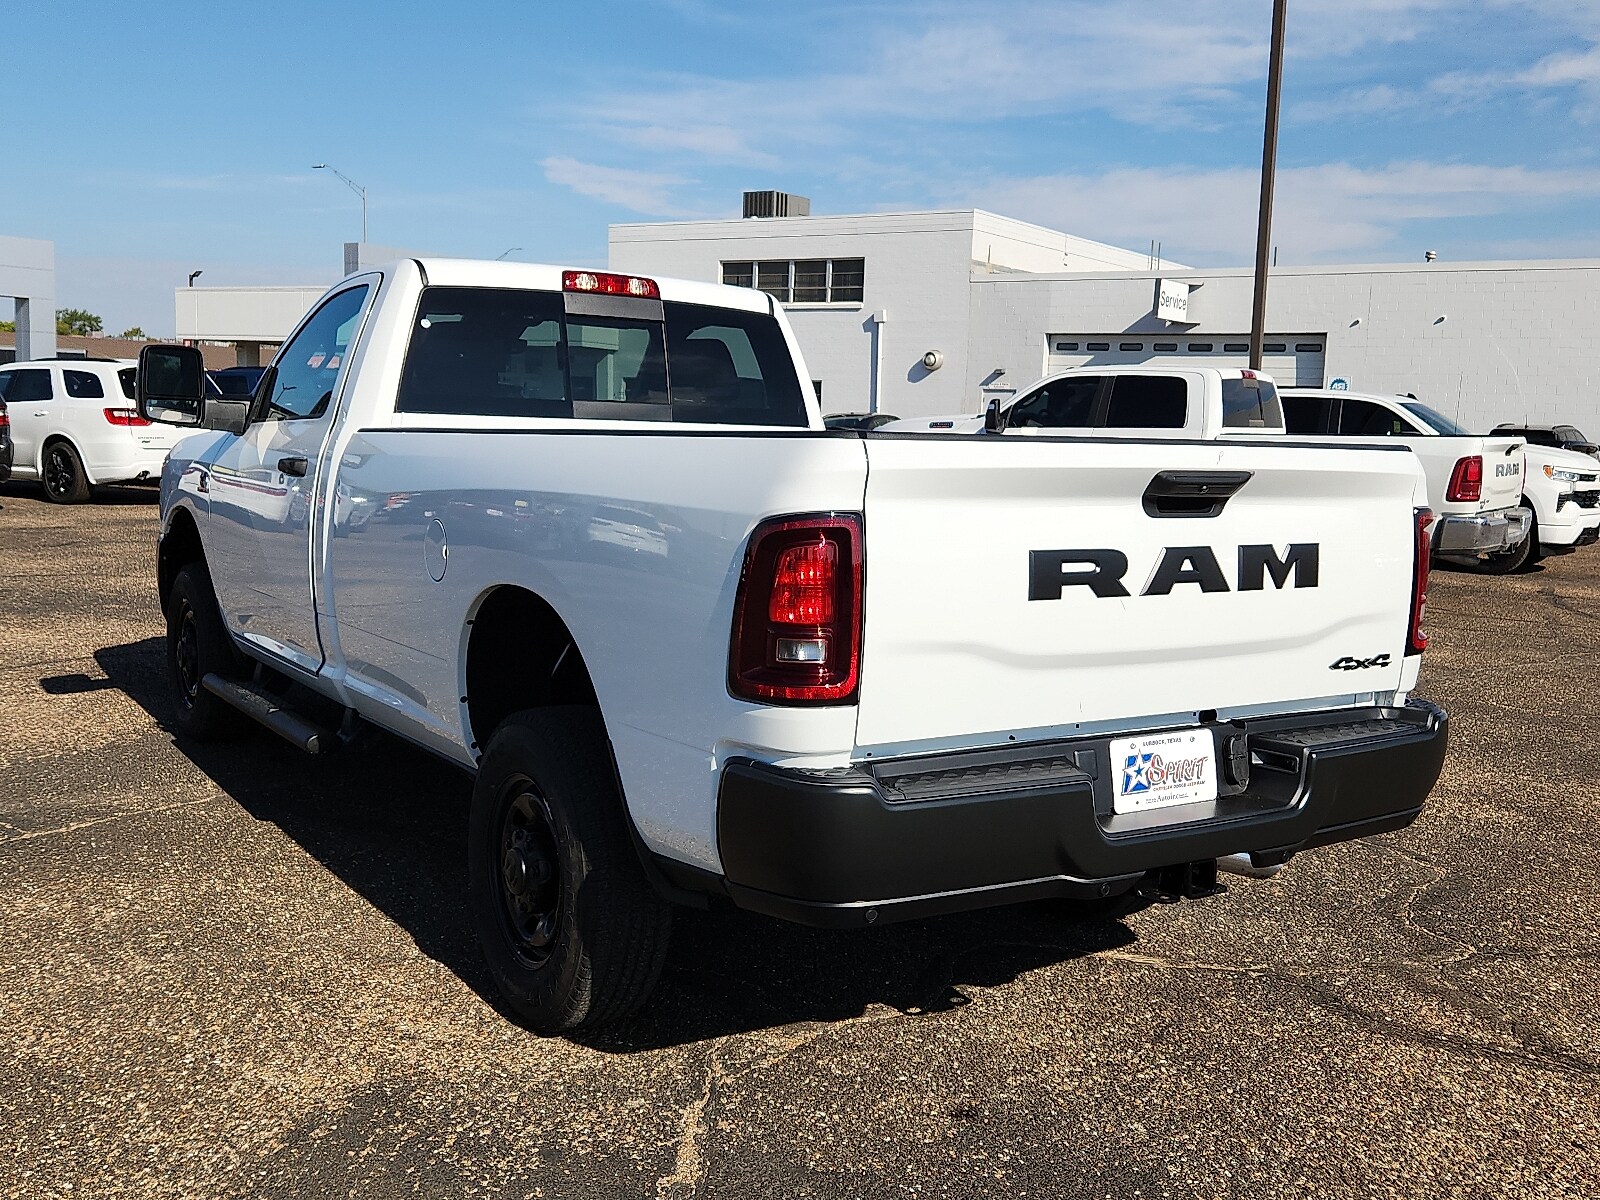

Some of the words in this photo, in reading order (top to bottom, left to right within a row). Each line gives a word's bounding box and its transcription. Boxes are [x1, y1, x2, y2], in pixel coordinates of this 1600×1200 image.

[1160, 290, 1187, 311] Service
[1495, 463, 1520, 478] RAM
[1027, 542, 1320, 602] RAM
[1328, 653, 1392, 672] 4x4
